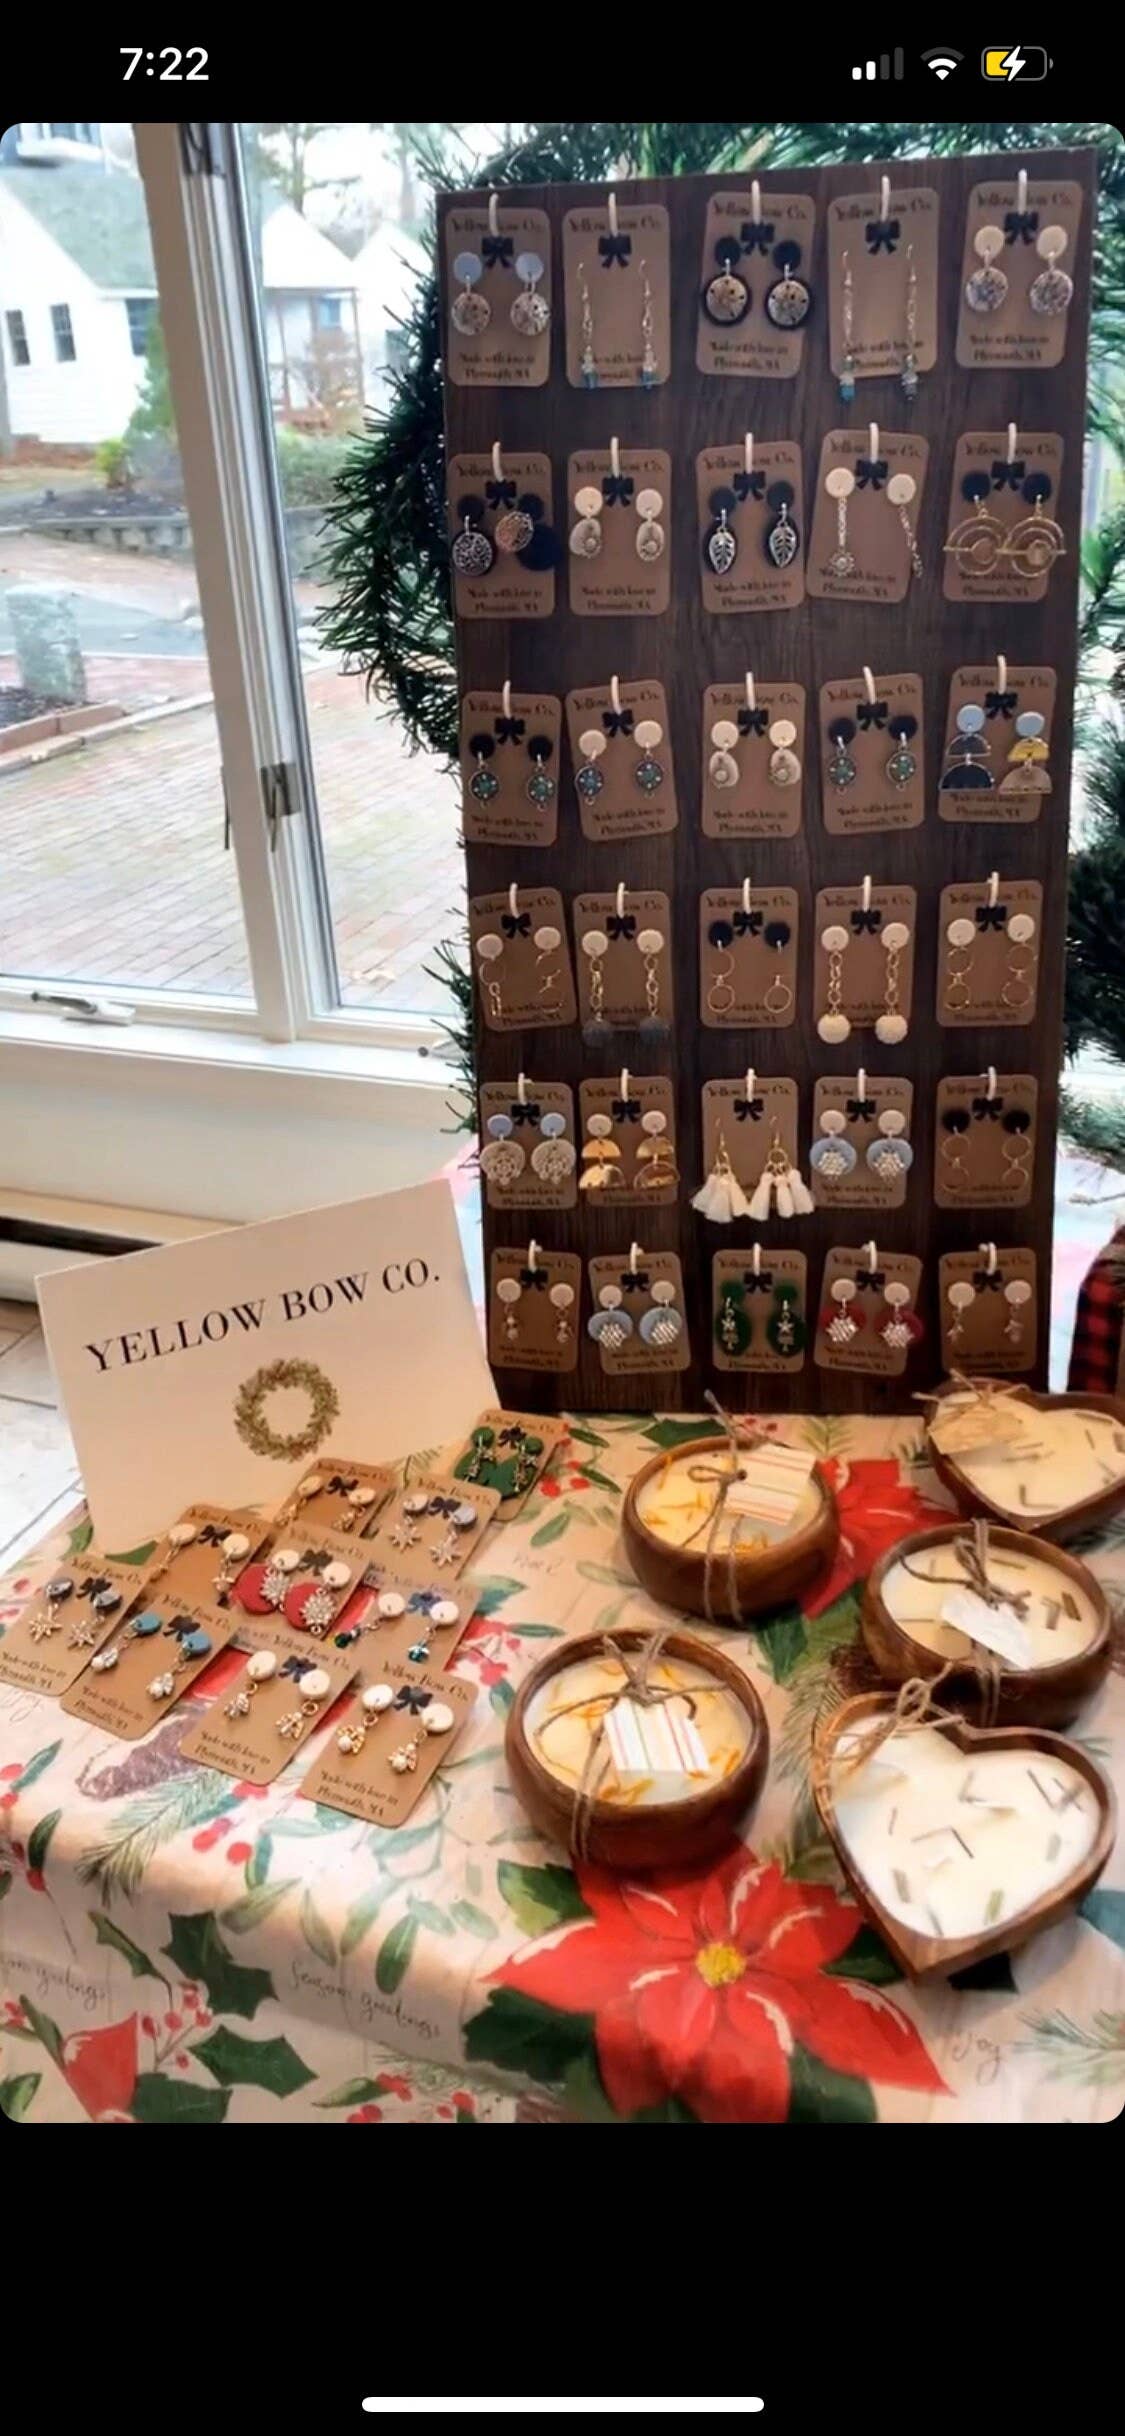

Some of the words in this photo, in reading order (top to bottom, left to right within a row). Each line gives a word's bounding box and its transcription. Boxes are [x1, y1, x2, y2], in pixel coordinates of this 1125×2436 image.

[85, 1299, 266, 1374] YELLOW
[279, 1272, 369, 1321] BOW
[382, 1258, 440, 1294] CO.
